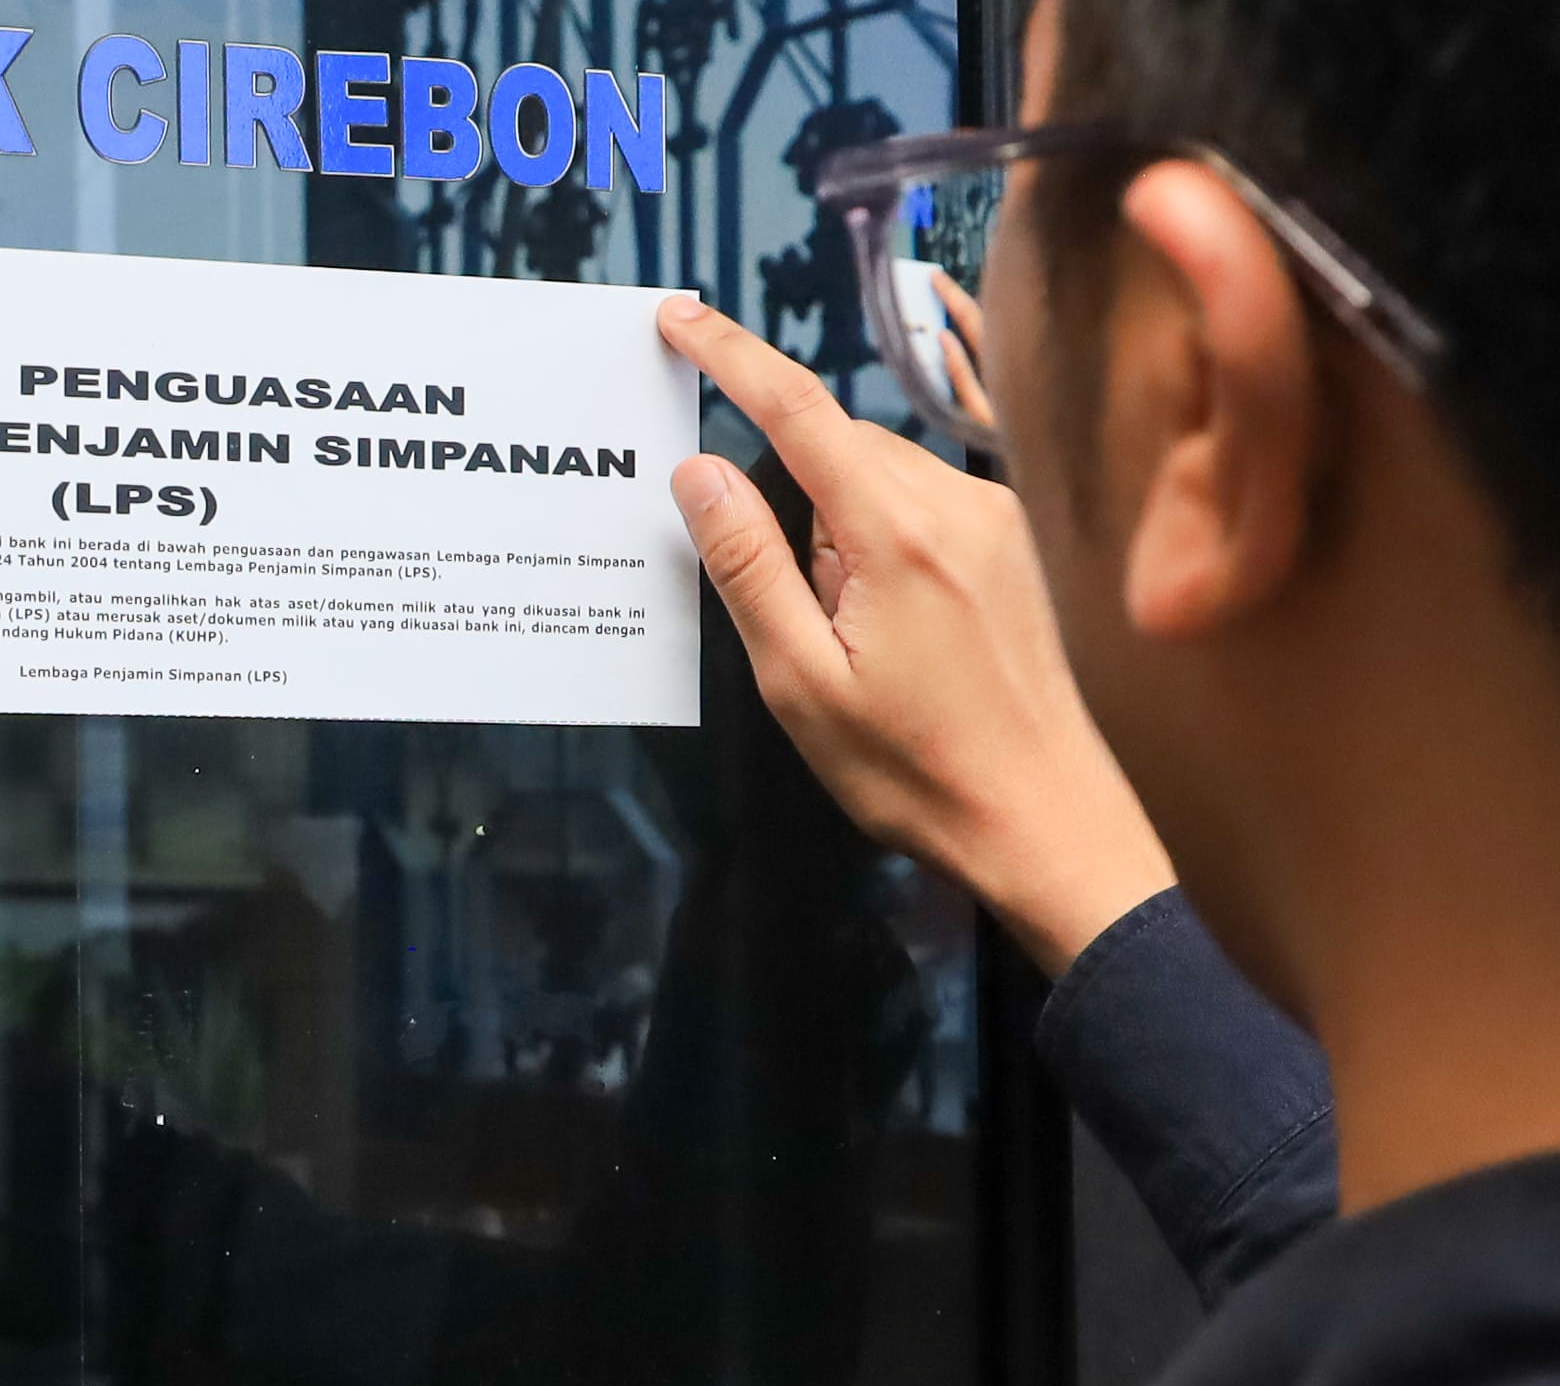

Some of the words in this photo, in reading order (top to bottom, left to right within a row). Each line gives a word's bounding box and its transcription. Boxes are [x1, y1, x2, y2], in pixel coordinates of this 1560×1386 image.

[77, 34, 667, 195] CIREBON
[19, 363, 466, 417] PENGUASAAN
[313, 434, 637, 480] SIMPANAN
[50, 480, 219, 527] (LPS)
[8, 535, 47, 550] bank
[52, 536, 72, 550] ini
[78, 537, 131, 552] berada
[136, 539, 151, 553] di
[157, 540, 206, 555] bawah
[212, 545, 302, 559] penguasaan
[307, 545, 334, 559] dan
[340, 549, 431, 563] pengawasan
[436, 549, 501, 566] Lembaga
[506, 552, 572, 568] Penjamin
[577, 554, 645, 571] Simpanan
[16, 553, 65, 568] Tahun
[70, 555, 109, 569] 2004
[112, 557, 172, 574] tentang
[176, 558, 244, 576] Lembaga
[248, 561, 317, 577] Penjamin
[321, 562, 393, 580] Simpanan
[397, 565, 442, 582] (LPS).
[8, 606, 51, 624] (LPS)
[56, 609, 90, 622] atau
[96, 610, 161, 624] merusak
[167, 612, 276, 628] aset/dokumen
[281, 614, 318, 628] milik
[322, 616, 355, 629] atau
[359, 619, 395, 633] yang
[400, 617, 460, 632] dikuasai
[464, 618, 500, 633] bank
[504, 620, 526, 636] ini,
[531, 620, 590, 635] diancam
[594, 622, 646, 639] dengan
[68, 591, 103, 605] atau
[110, 593, 207, 609] mengalihkan
[215, 594, 242, 609] hak
[249, 596, 281, 610] atas
[287, 597, 395, 613] aset/dokumen
[401, 600, 437, 614] milik
[443, 602, 475, 615] atau
[481, 605, 516, 619] yang
[522, 604, 581, 618] dikuasai
[588, 605, 622, 619] bank
[628, 606, 646, 620] ini
[54, 626, 108, 641] Hukum
[112, 627, 164, 642] Pidana
[168, 628, 229, 646] (KUHP).
[19, 665, 89, 682] Lembaga
[93, 666, 164, 683] Penjamin
[168, 668, 242, 685] Simpanan
[247, 669, 288, 686] (LPS)
